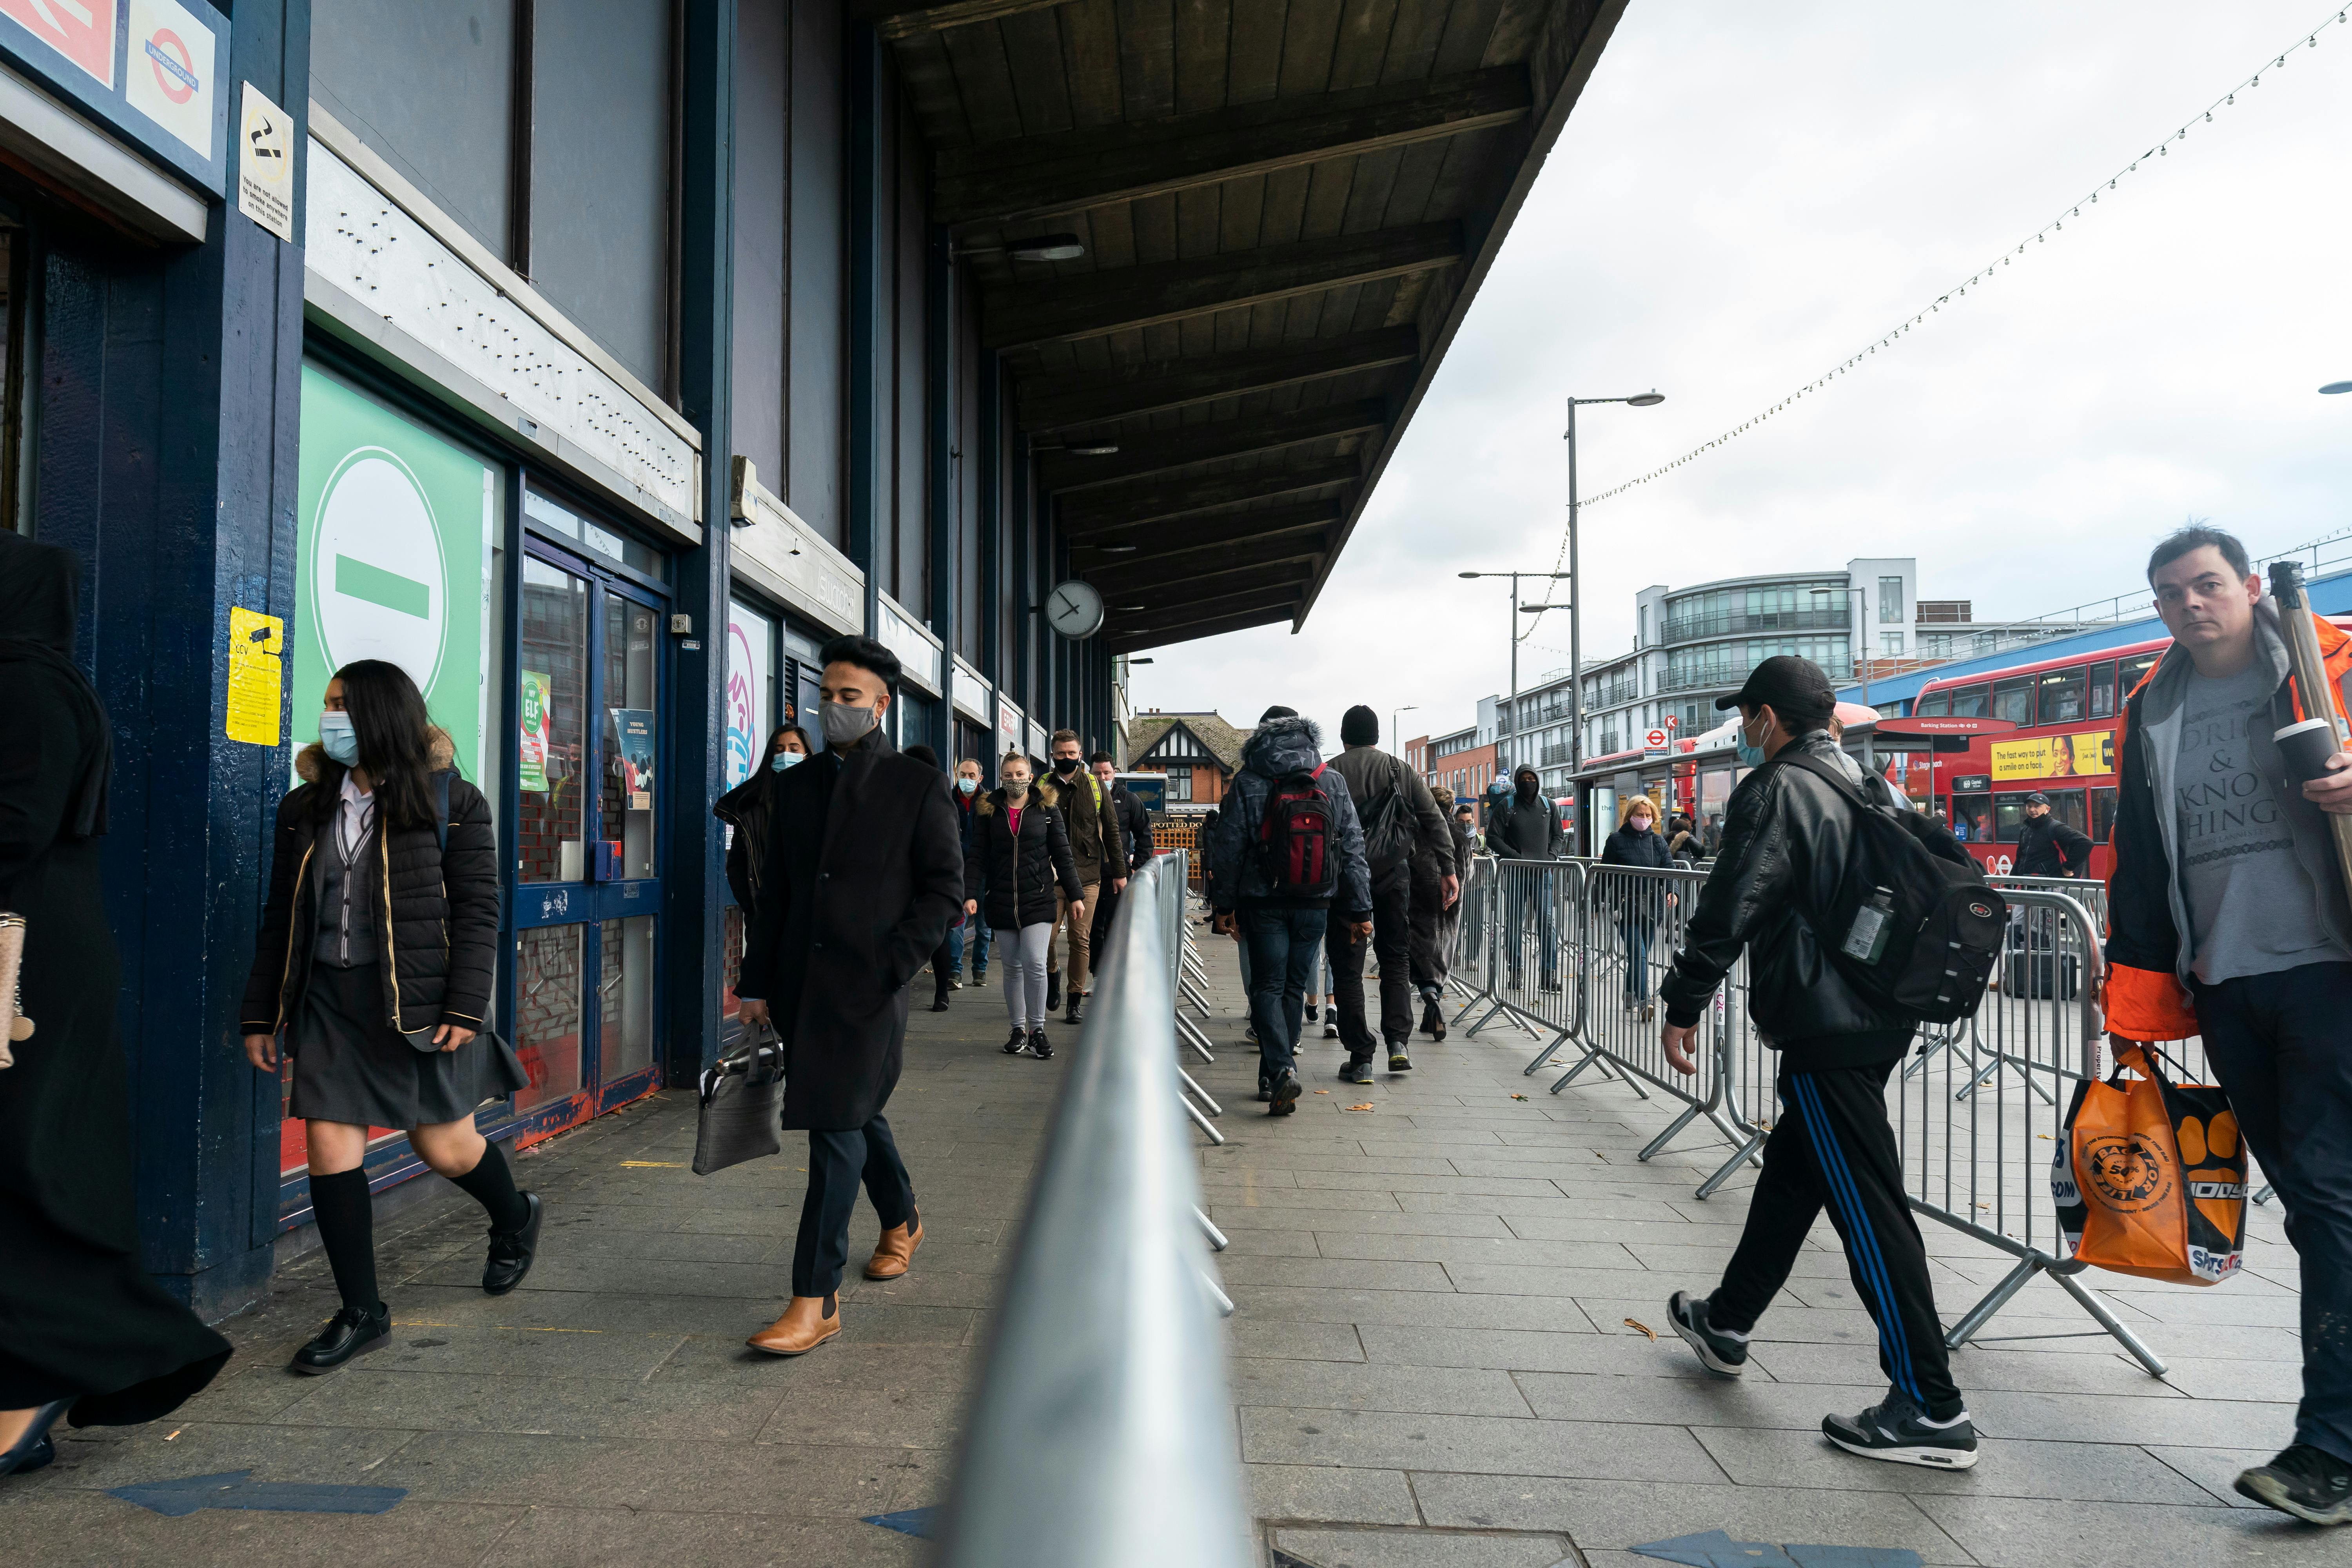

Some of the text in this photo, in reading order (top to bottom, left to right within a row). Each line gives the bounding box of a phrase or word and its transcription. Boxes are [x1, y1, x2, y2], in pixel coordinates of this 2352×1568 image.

[149, 44, 196, 87] UNDERGROUND
[243, 174, 252, 187] You
[253, 183, 261, 192] are
[272, 196, 288, 211] allowed
[243, 186, 288, 221] to smoke anywhere
[248, 201, 283, 228] on this station
[529, 689, 536, 698] MY
[525, 699, 539, 720] ELF
[1004, 713, 1013, 731] SPAR
[1668, 717, 1676, 727] K
[2018, 751, 2028, 760] way
[2036, 749, 2046, 759] put
[2209, 749, 2236, 773] &
[2004, 762, 2017, 771] smile
